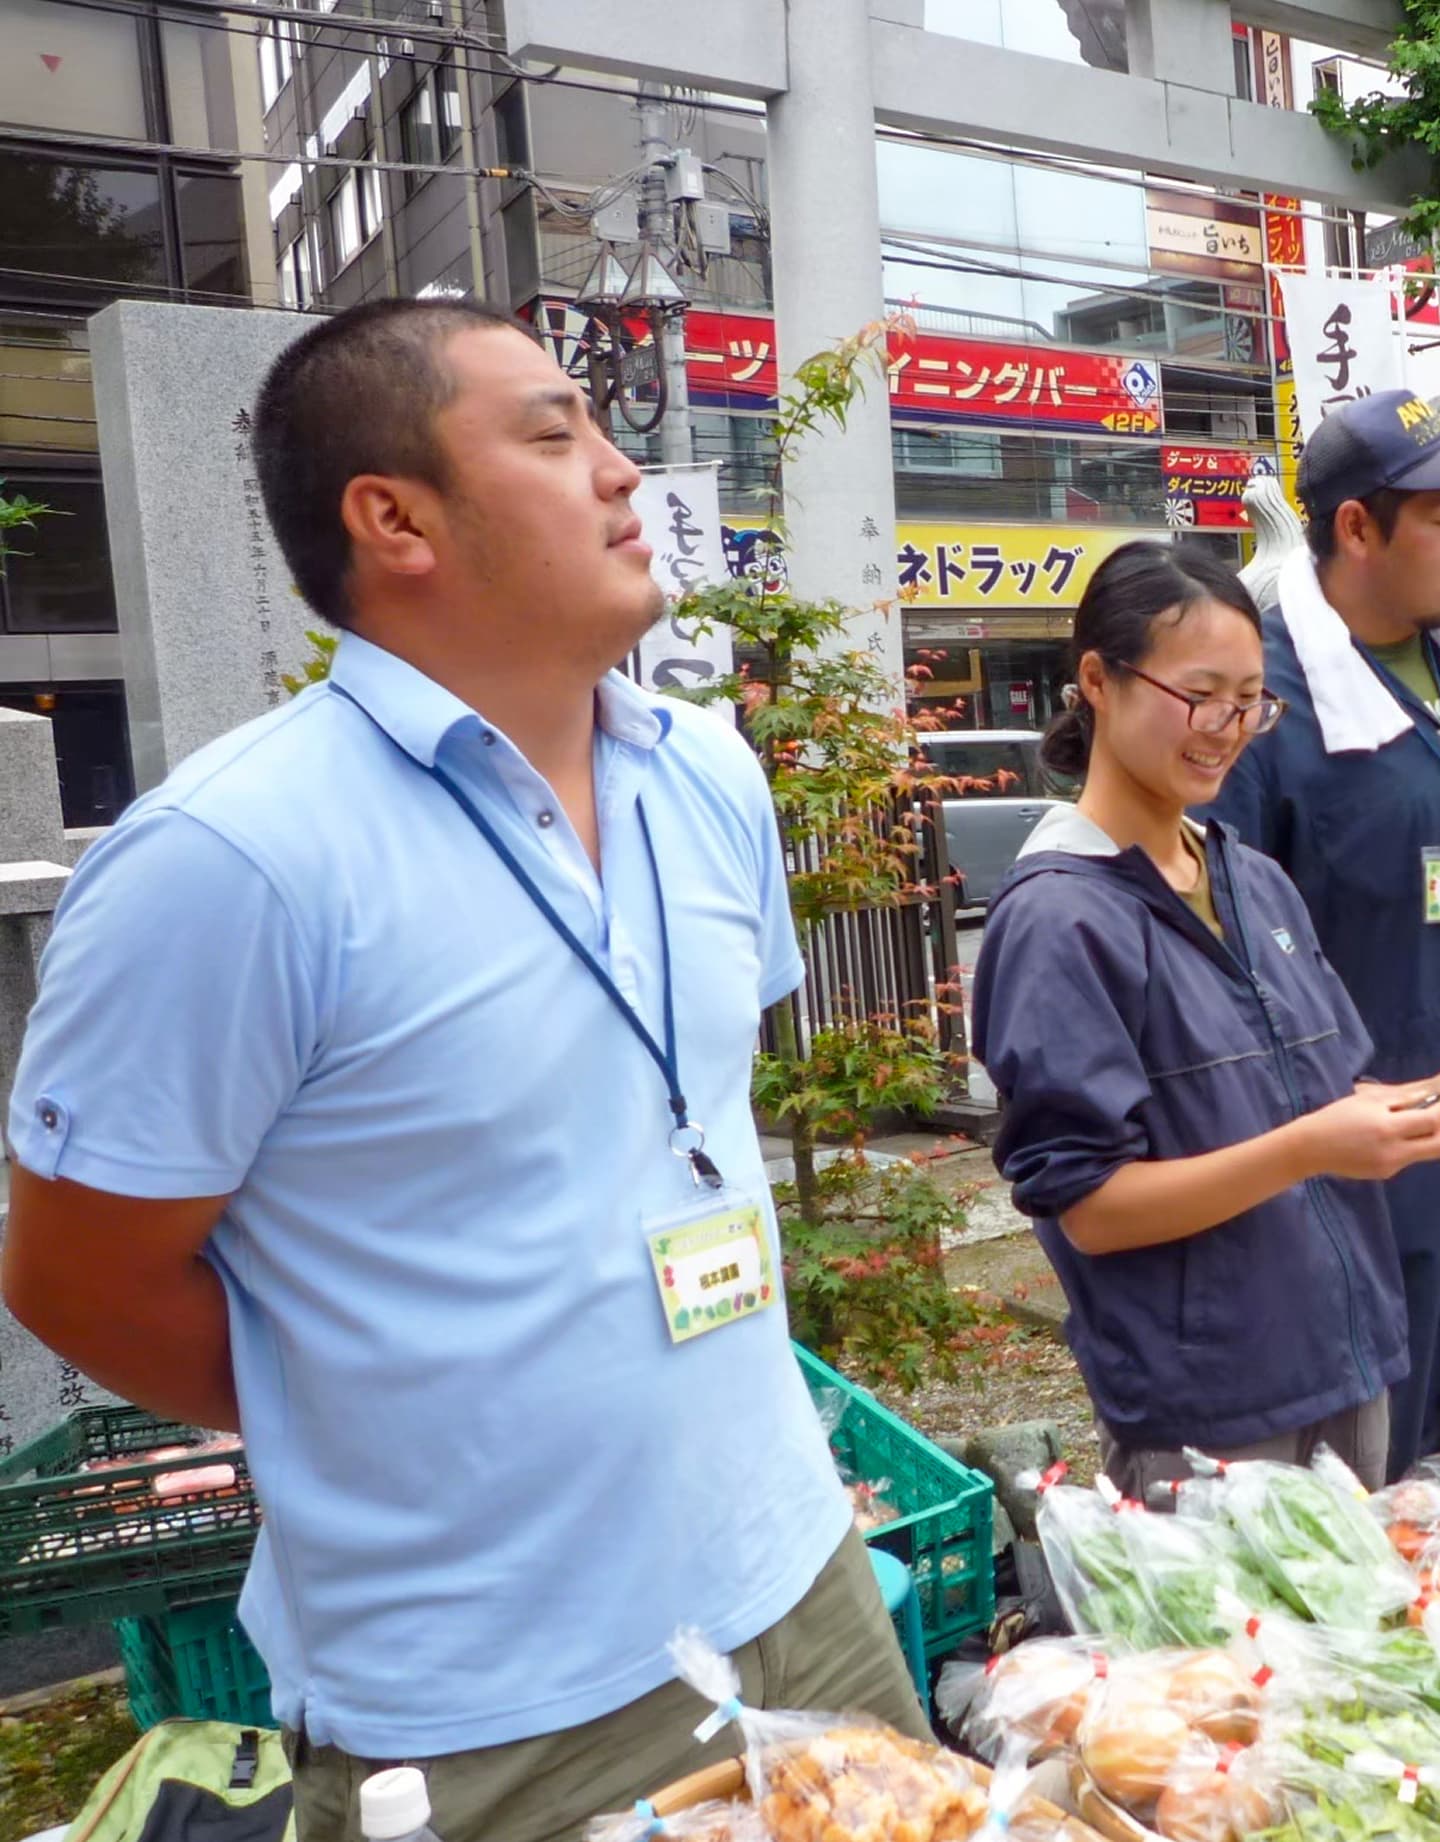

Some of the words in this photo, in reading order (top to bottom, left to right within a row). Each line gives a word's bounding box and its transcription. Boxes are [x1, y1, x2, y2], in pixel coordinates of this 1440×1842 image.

[1115, 412, 1145, 433] 2F
[1167, 451, 1205, 468] ダーツ
[1206, 455, 1219, 470] &
[1167, 476, 1251, 496] ダイニングバー
